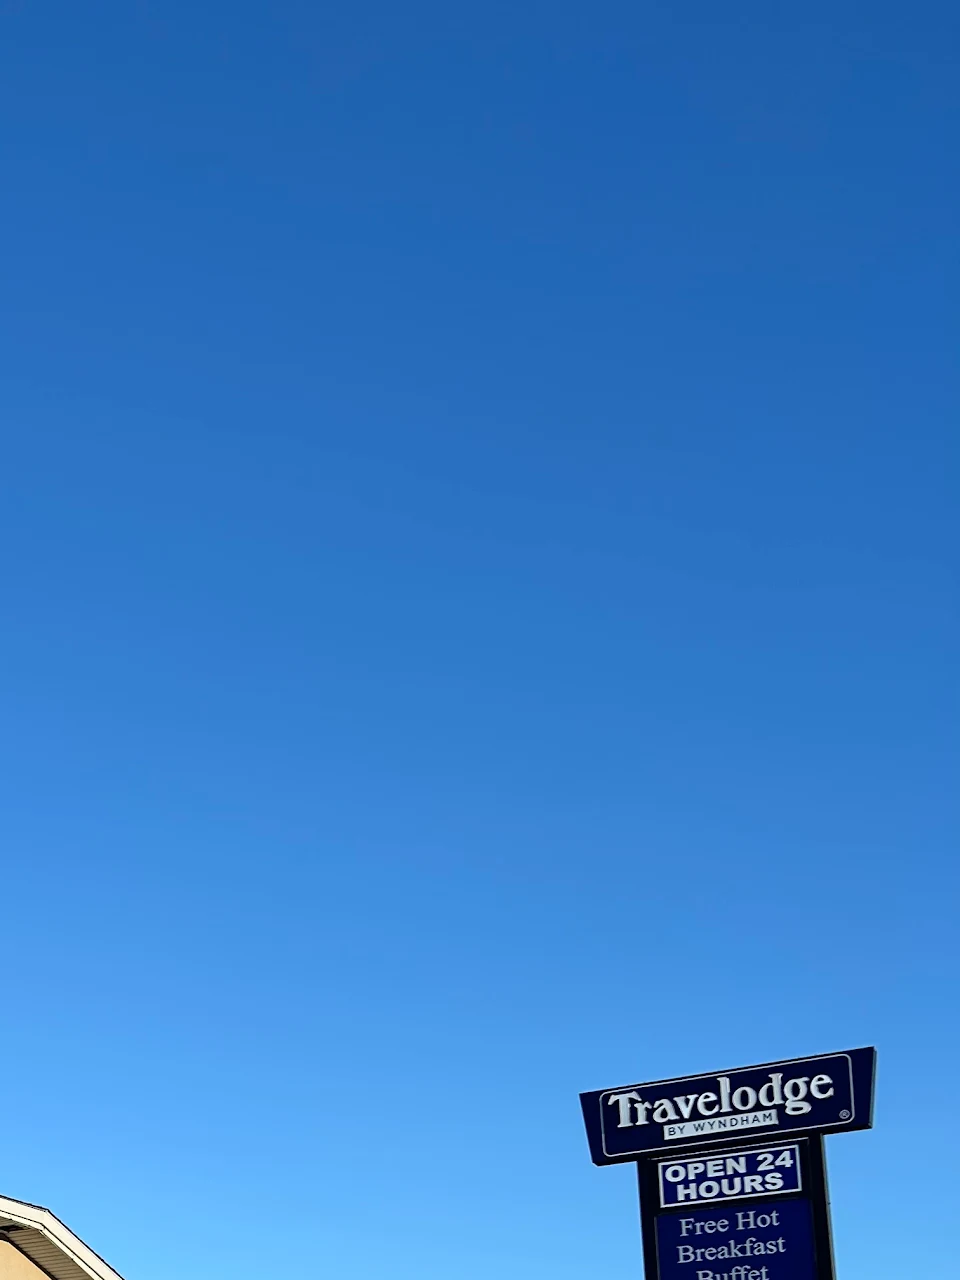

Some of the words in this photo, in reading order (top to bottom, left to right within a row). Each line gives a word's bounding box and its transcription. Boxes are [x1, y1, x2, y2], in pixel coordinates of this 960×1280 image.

[608, 1072, 834, 1128] Travelodge
[667, 1125, 686, 1136] BY
[693, 1112, 774, 1132] WYNDHAM
[664, 1156, 746, 1183] OPEN
[756, 1151, 794, 1172] 24
[677, 1172, 784, 1202] HOURS
[679, 1218, 729, 1237] Free
[736, 1210, 780, 1231] Hot
[677, 1236, 786, 1264] Breakfast
